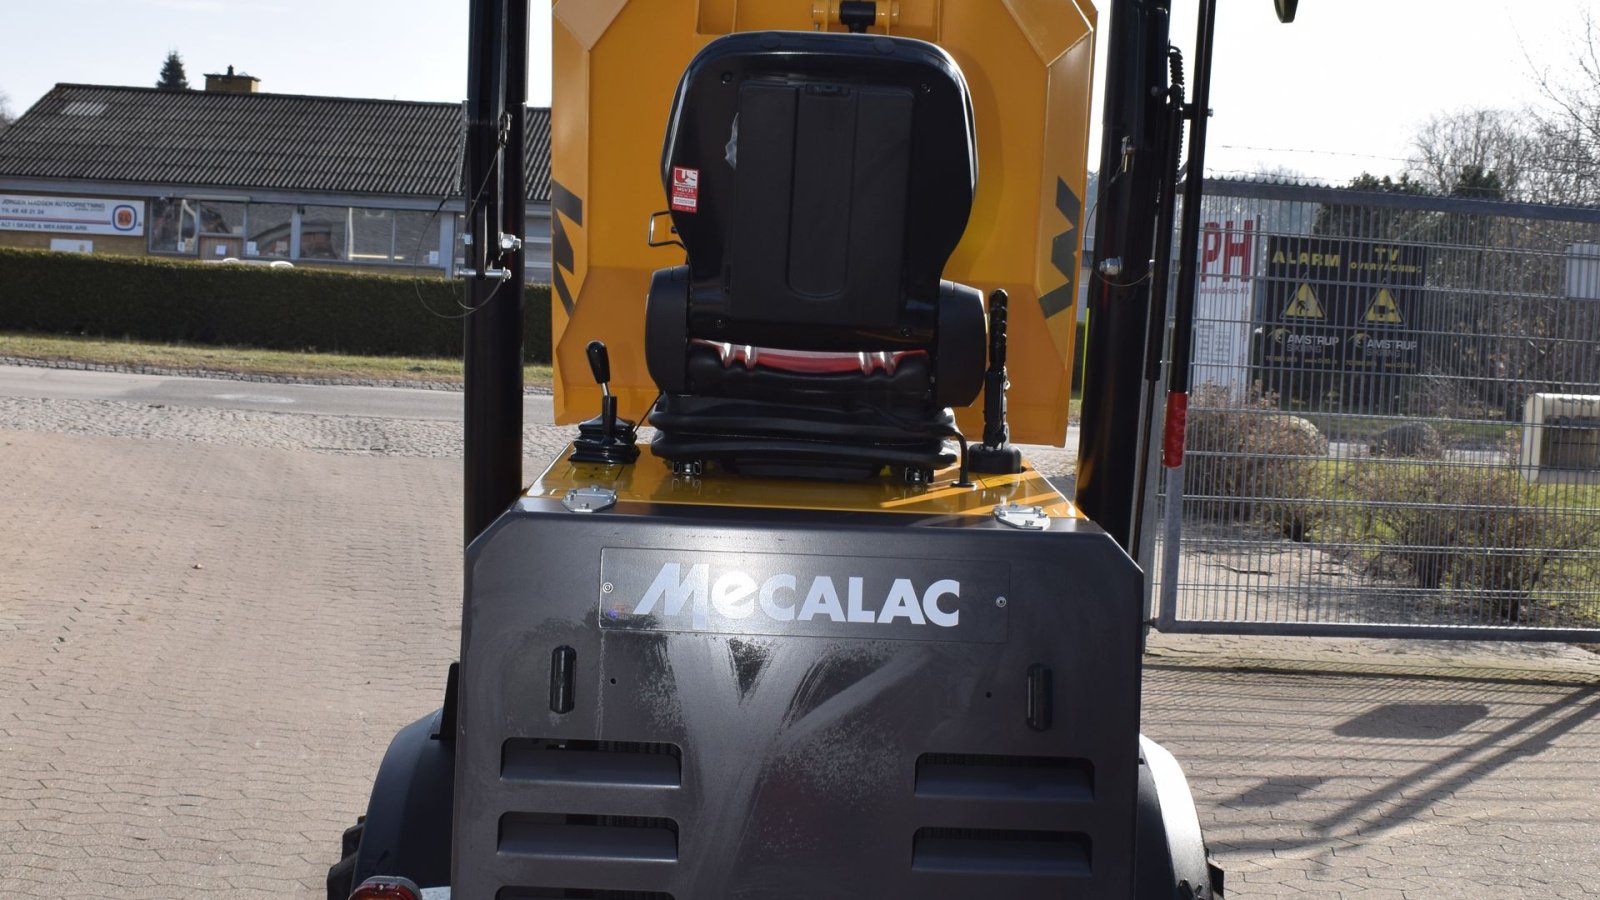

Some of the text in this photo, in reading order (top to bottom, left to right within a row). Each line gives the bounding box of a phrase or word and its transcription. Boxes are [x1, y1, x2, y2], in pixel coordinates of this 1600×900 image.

[1201, 220, 1253, 282] PH
[1272, 250, 1341, 267] ALARM
[1375, 247, 1400, 262] TV
[1287, 334, 1340, 346] AMSTRUP
[1366, 339, 1417, 351] AMSTRUP
